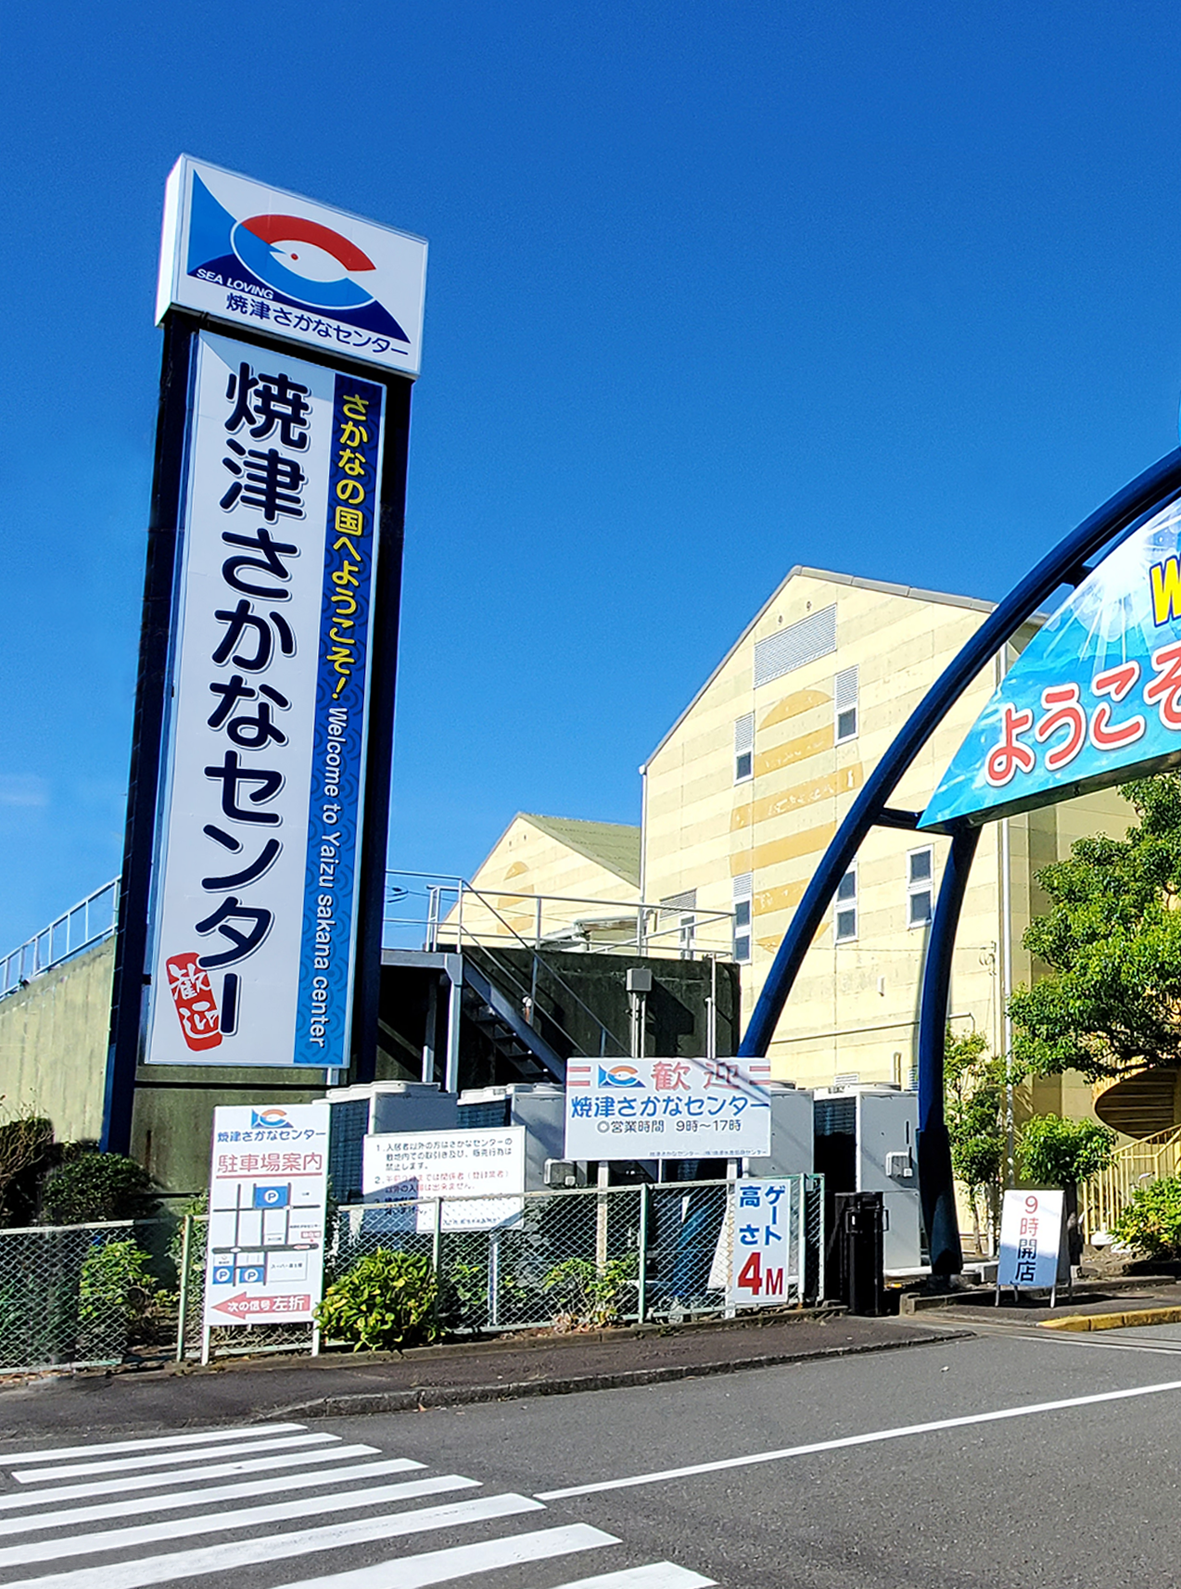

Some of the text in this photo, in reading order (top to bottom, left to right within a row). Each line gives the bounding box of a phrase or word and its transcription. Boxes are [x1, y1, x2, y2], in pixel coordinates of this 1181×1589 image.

[196, 268, 275, 300] SEA LOVING
[226, 292, 409, 356] 焼津さかなセンター
[194, 361, 310, 1035] 焼津さかなセンター
[308, 706, 348, 1049] Welcome to Yaizu sakana center
[651, 1061, 739, 1092] 歓迎
[571, 1095, 769, 1118] 焼津さかなセンター
[217, 1129, 326, 1142] 焼津さかなセンター
[217, 1152, 322, 1173] 駐車場案内
[739, 1185, 762, 1246] 高さ
[764, 1184, 786, 1246] ゲート
[1015, 1195, 1039, 1282] 9時開店
[738, 1252, 784, 1296] 4M
